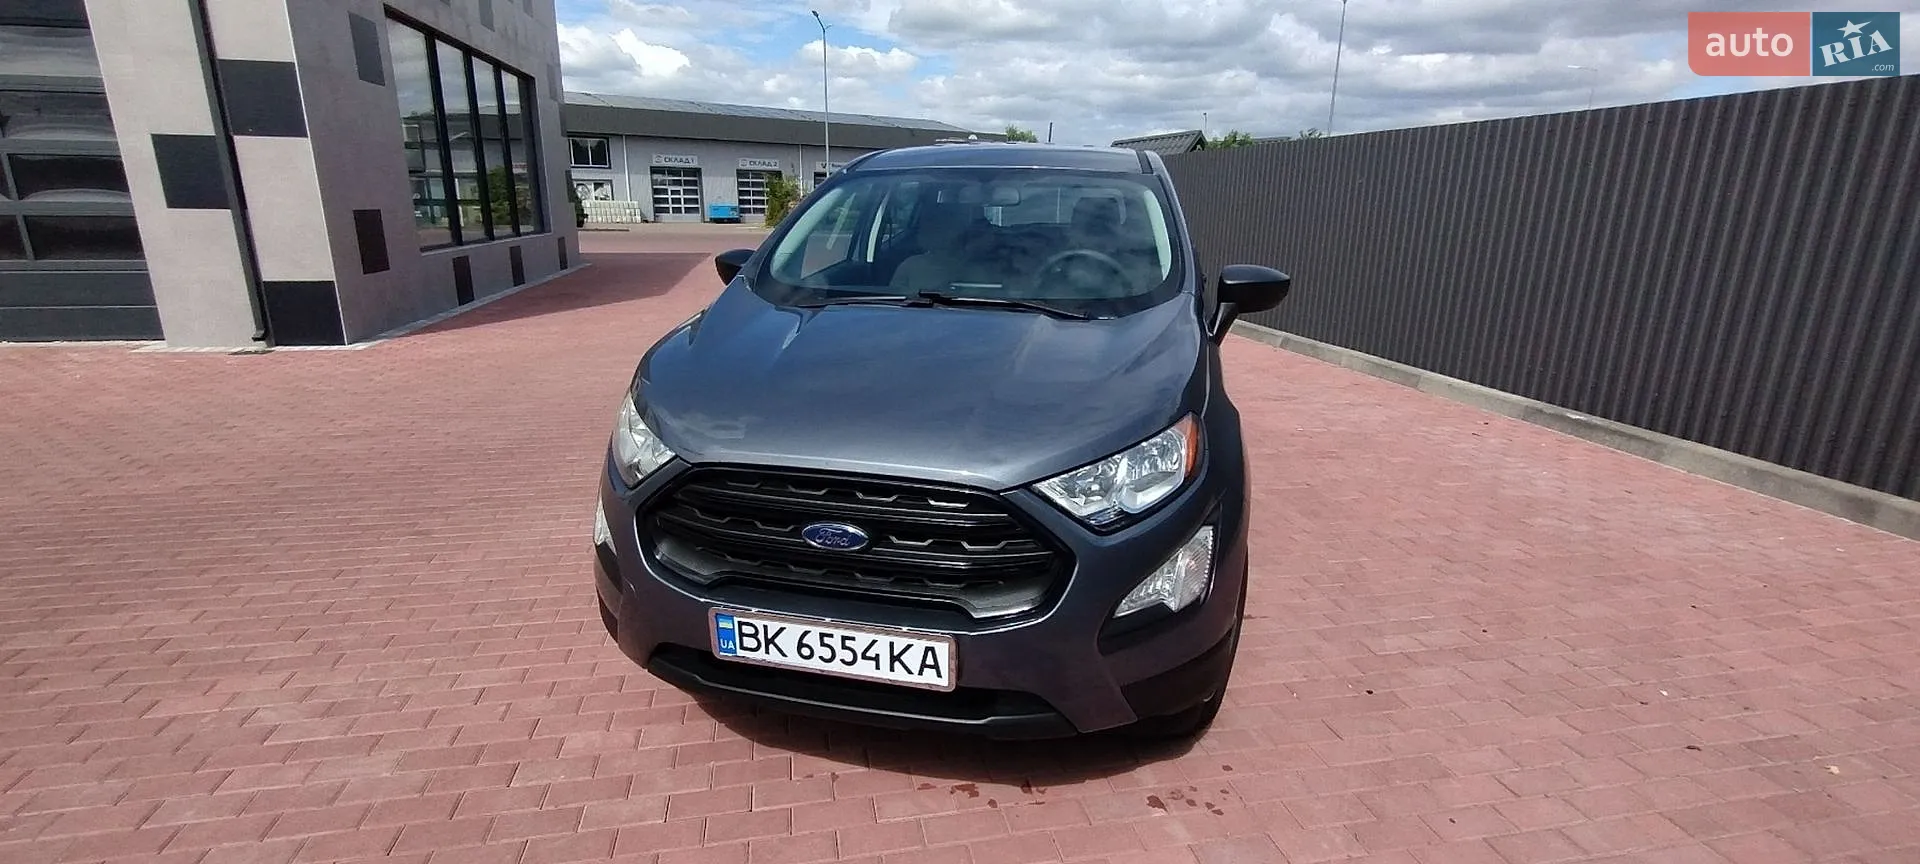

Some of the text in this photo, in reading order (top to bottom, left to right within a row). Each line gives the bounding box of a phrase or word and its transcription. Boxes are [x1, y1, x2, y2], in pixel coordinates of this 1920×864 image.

[664, 156, 690, 164] СКЛАД
[749, 160, 773, 168] СКЛАД
[815, 527, 850, 546] Ford
[720, 639, 735, 651] UA
[737, 620, 943, 679] BK 6554 KA
